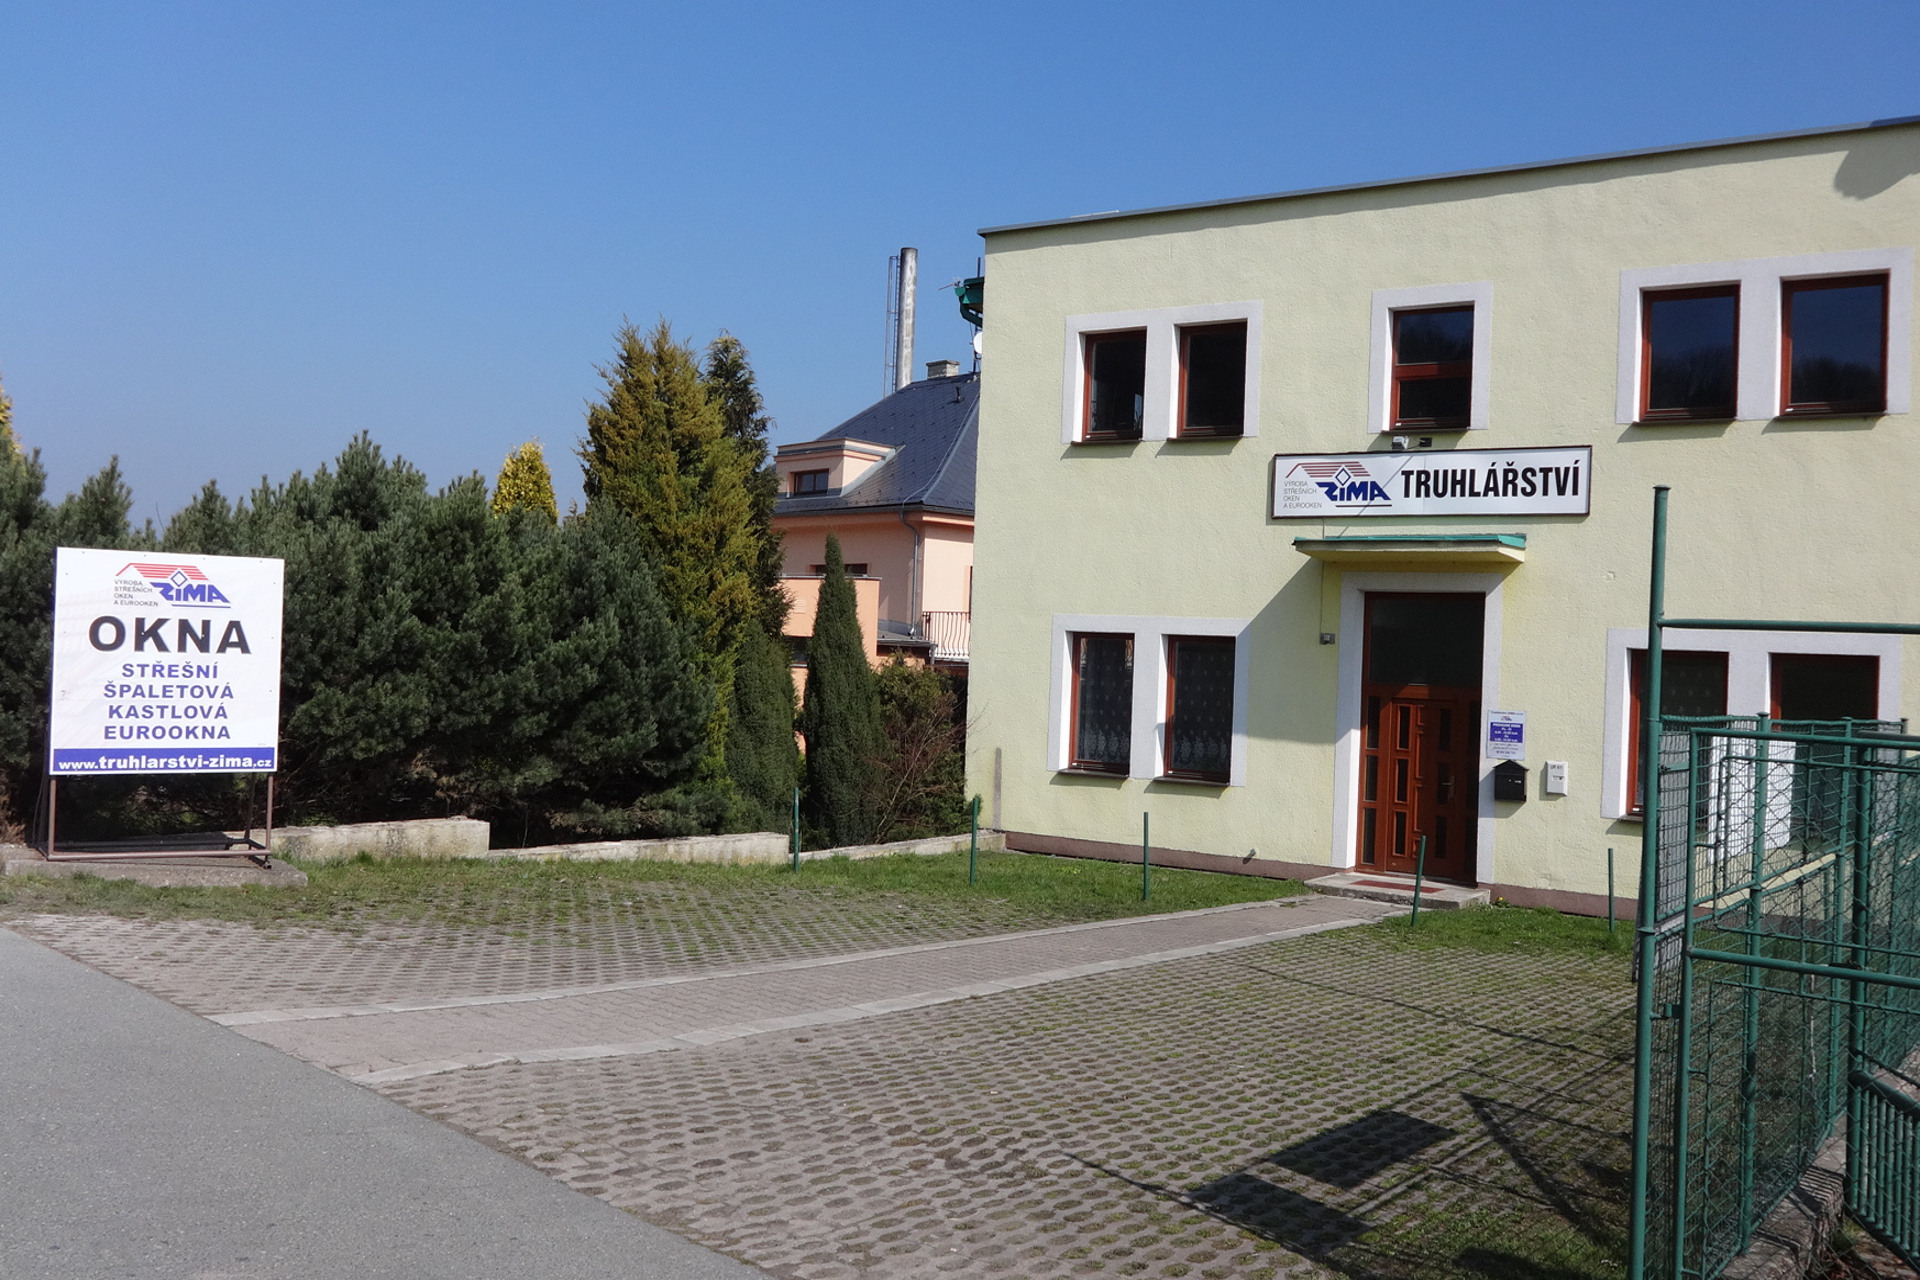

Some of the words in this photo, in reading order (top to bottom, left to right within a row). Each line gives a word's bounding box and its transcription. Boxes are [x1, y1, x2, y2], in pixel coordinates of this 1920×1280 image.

[1401, 460, 1580, 498] TRUHLÁŘSTVÍ
[120, 599, 158, 607] EUROOKEN
[88, 615, 252, 655] OKNA
[121, 660, 218, 678] STŘEŠNÍ
[103, 680, 234, 699] ŠPALETOVÁ
[108, 702, 228, 719] KASTLOVÁ
[104, 725, 231, 740] EUROOKNA
[58, 755, 272, 769] www.truhlarstvi-zima.cz
